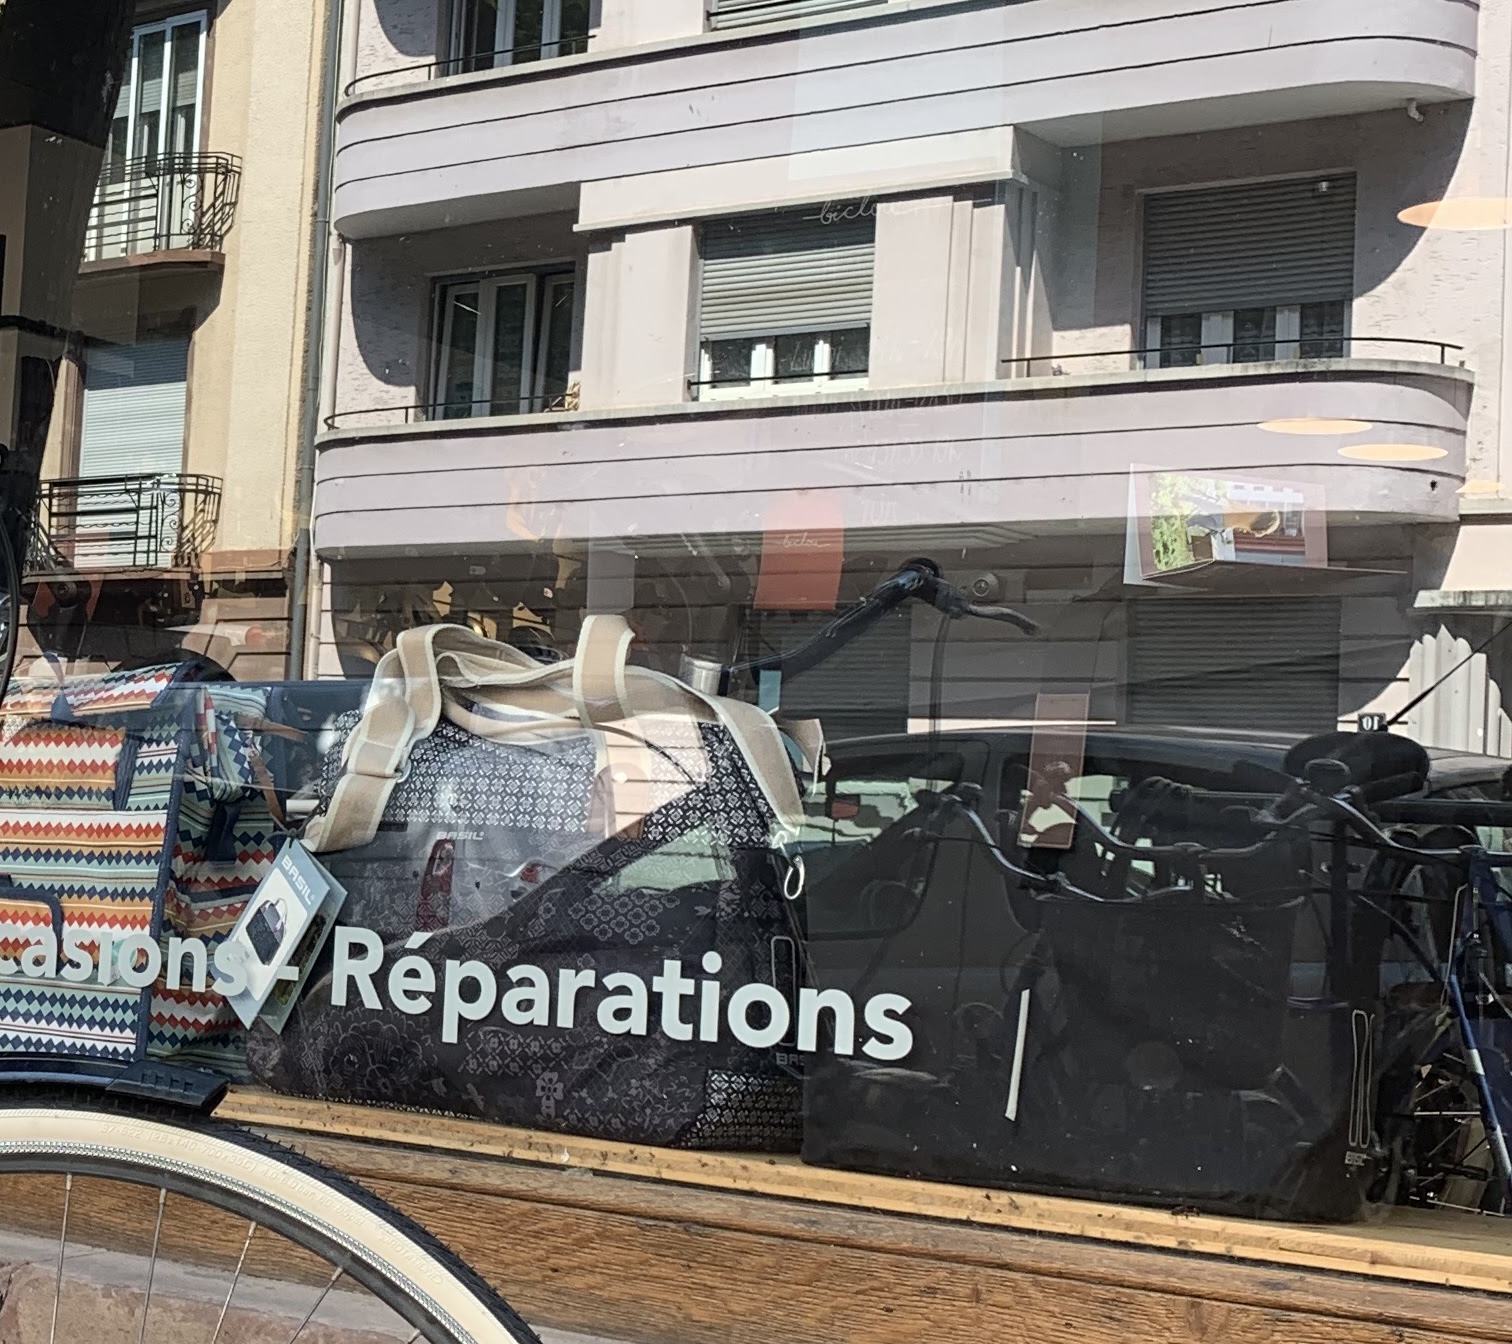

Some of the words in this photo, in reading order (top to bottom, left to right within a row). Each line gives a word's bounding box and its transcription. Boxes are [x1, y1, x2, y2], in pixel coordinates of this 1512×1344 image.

[436, 831, 484, 841] BASIL
[281, 854, 315, 906] BASIL
[329, 924, 914, 1061] Réparations
